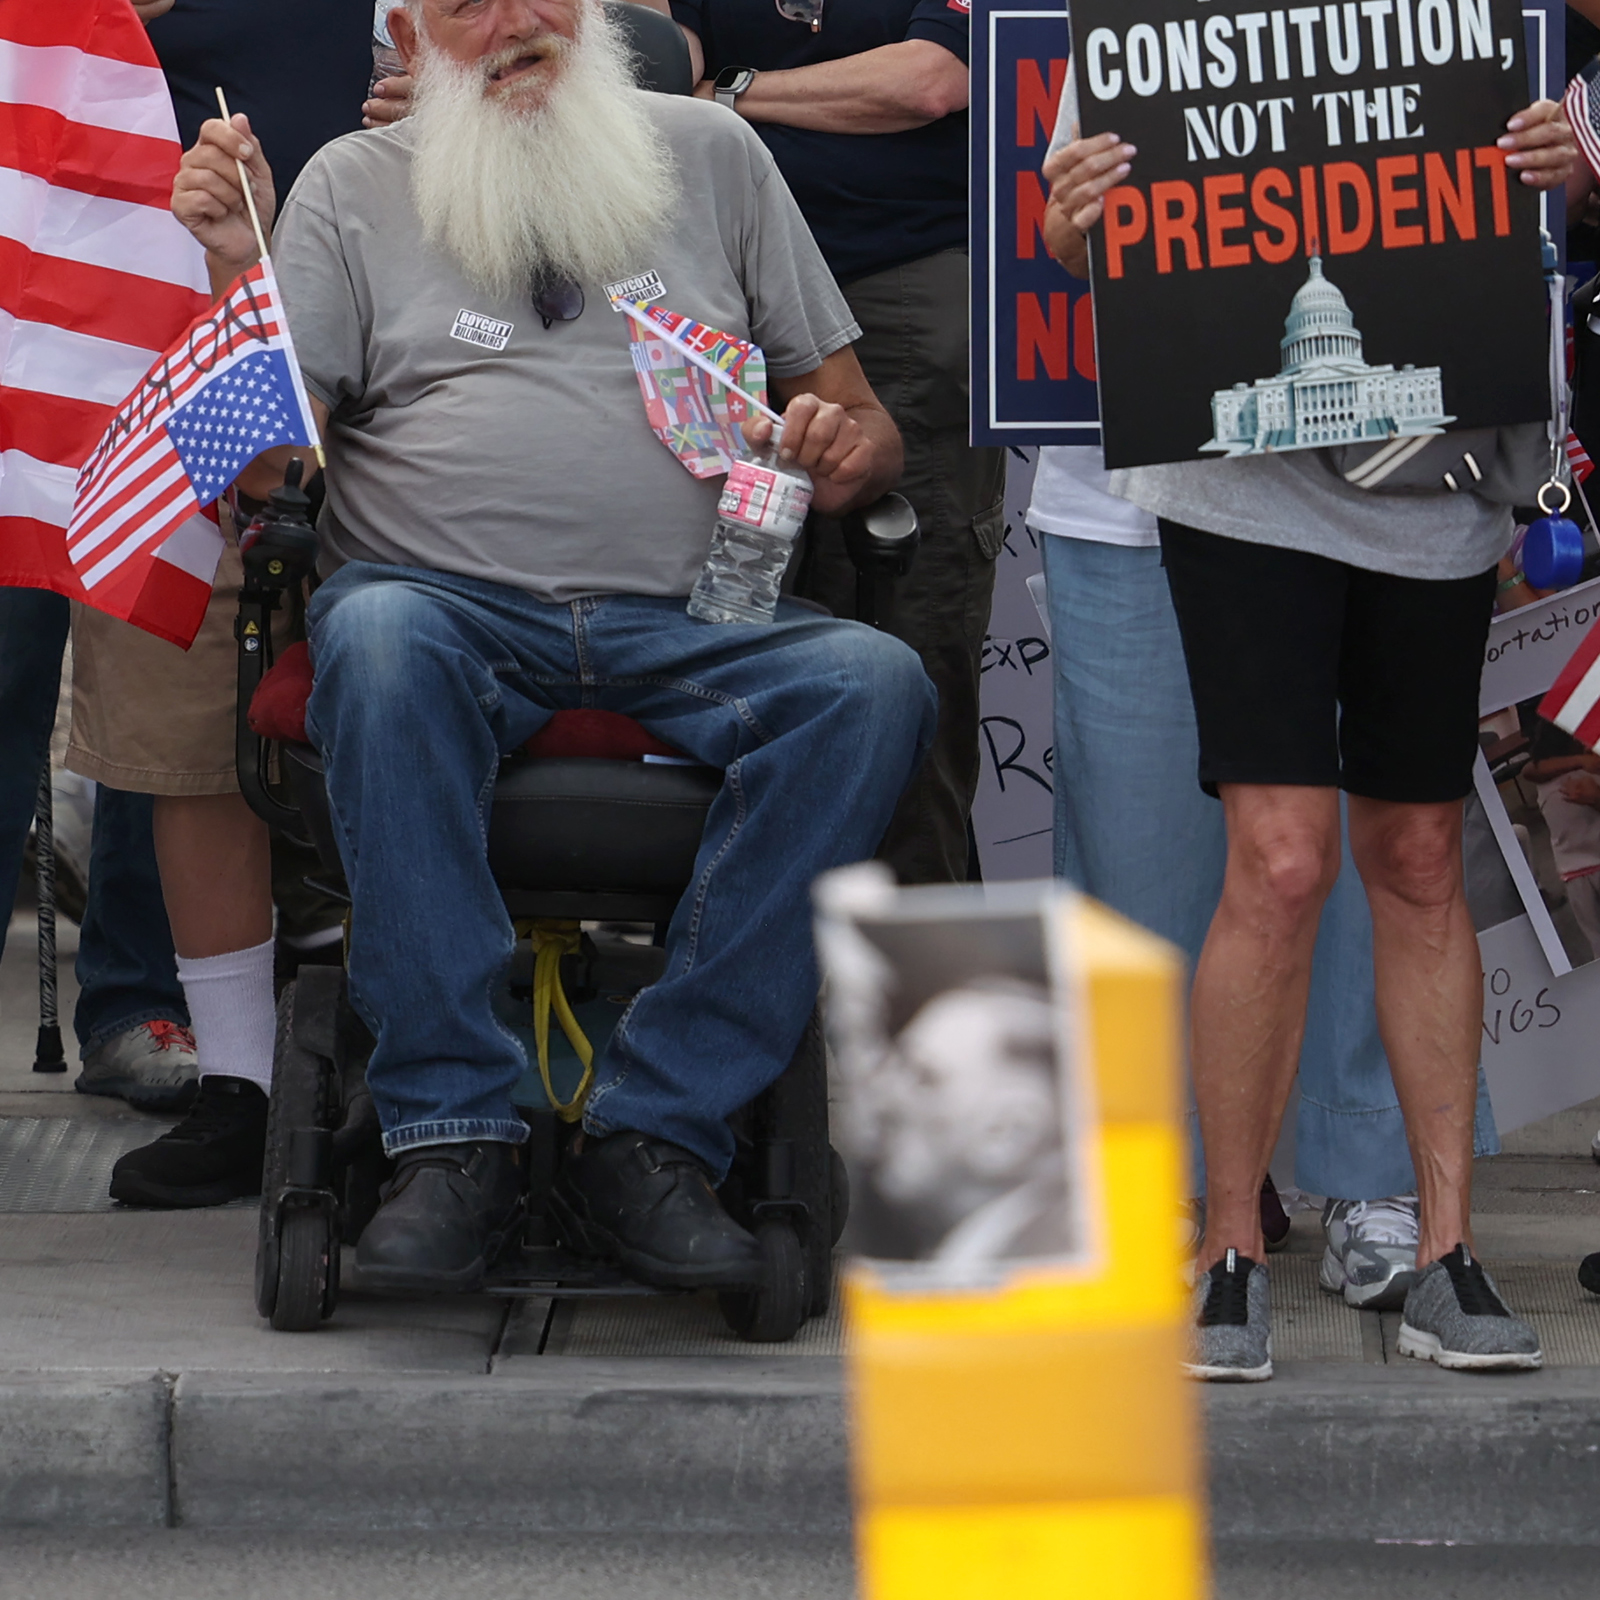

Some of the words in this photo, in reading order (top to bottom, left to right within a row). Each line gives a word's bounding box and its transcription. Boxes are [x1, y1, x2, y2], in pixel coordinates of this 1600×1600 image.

[1184, 97, 1294, 163] NOT
[1313, 84, 1425, 147] THE
[1100, 145, 1512, 280] PRESIDENT
[606, 272, 657, 297] BOYCOTT
[453, 325, 504, 349] BILLIONAIRES
[459, 311, 511, 337] BOYCOTT
